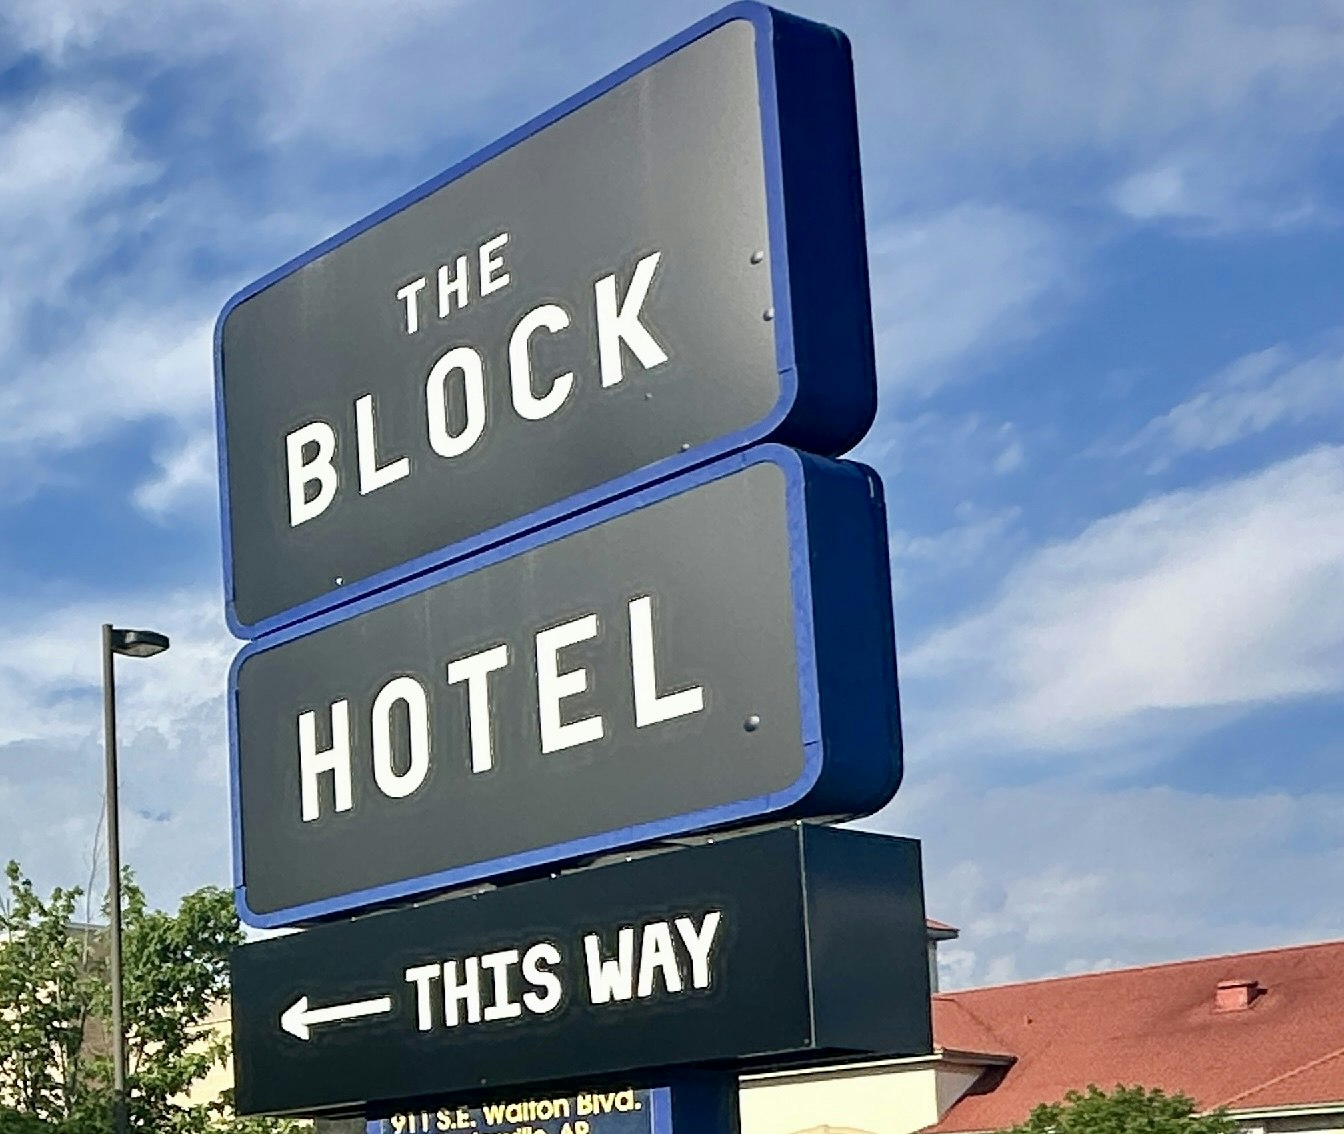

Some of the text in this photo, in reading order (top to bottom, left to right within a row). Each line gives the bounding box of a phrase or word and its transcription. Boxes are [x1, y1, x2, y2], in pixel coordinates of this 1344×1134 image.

[396, 232, 510, 334] THE
[285, 251, 668, 528] BLOCK
[297, 595, 704, 821] HOTEL
[405, 912, 721, 1031] THIS WAY
[436, 1108, 476, 1132] S.E.
[483, 1096, 570, 1126] Walton
[576, 1089, 642, 1117] Blvd.
